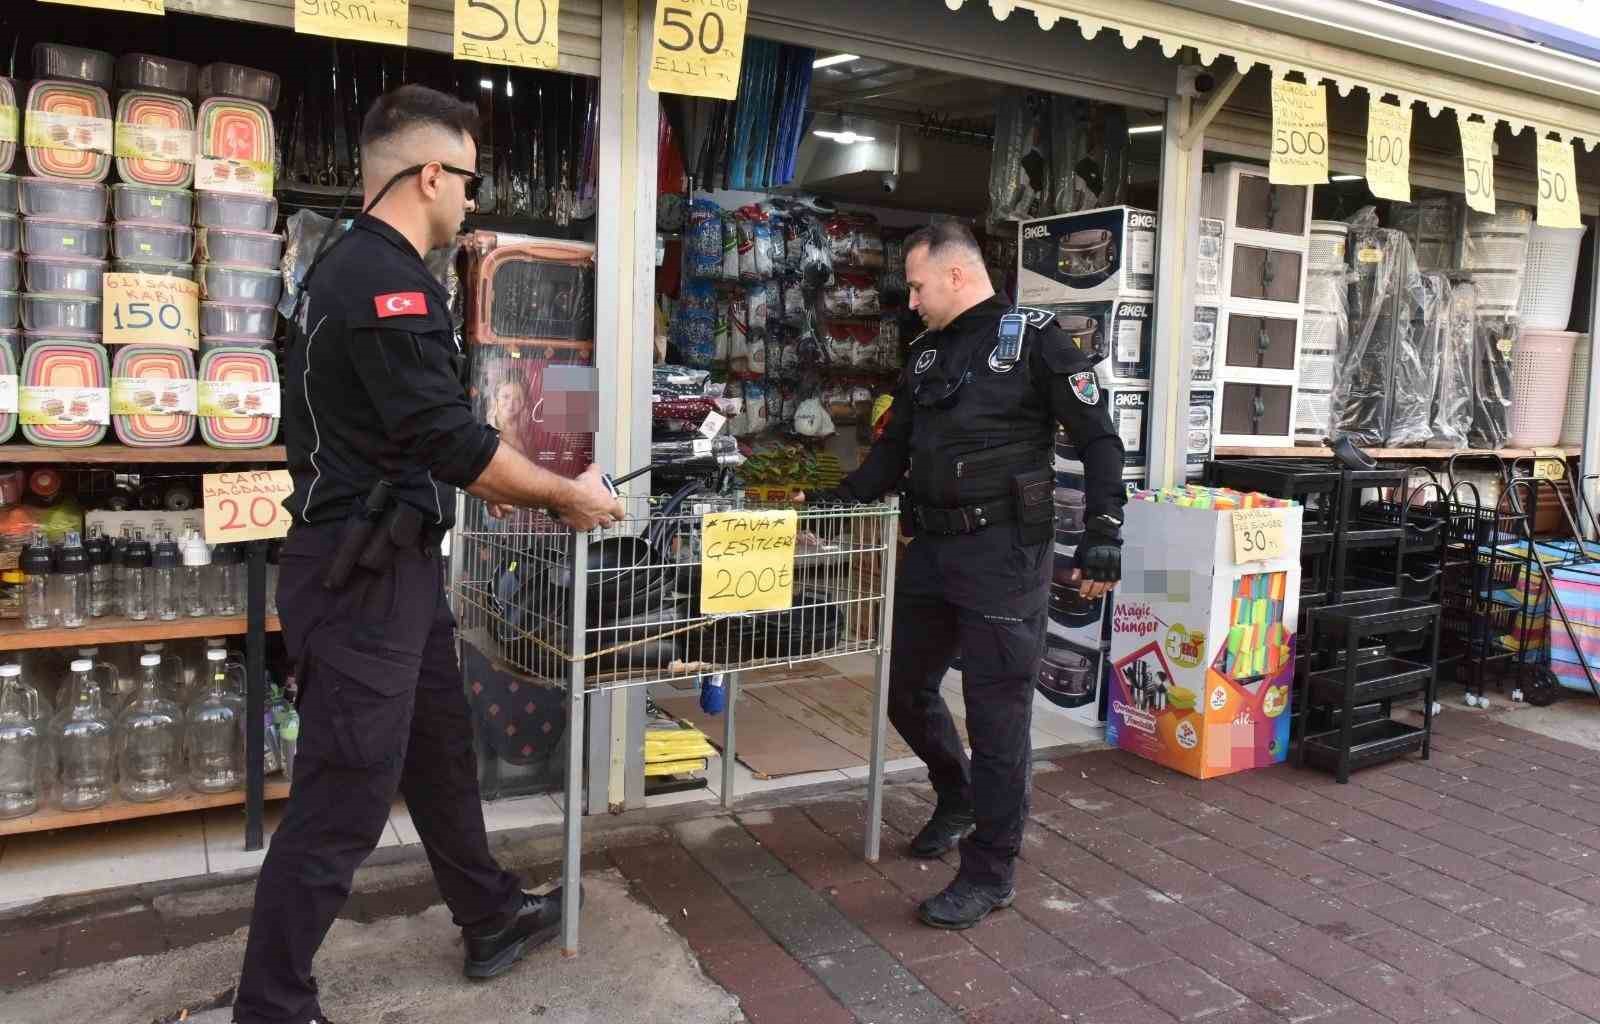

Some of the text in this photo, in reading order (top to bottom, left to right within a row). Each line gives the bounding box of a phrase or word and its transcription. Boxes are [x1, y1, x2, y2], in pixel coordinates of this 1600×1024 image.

[461, 0, 547, 45] 50
[658, 7, 724, 55] 50
[1275, 129, 1325, 155] 500
[1367, 135, 1403, 166] 100
[1466, 157, 1491, 198] 50
[1539, 168, 1567, 202] 50
[112, 302, 181, 330] 150
[219, 471, 273, 485] CAM
[218, 496, 277, 531] 20
[1243, 530, 1265, 552] 30
[1114, 603, 1152, 620] Magic
